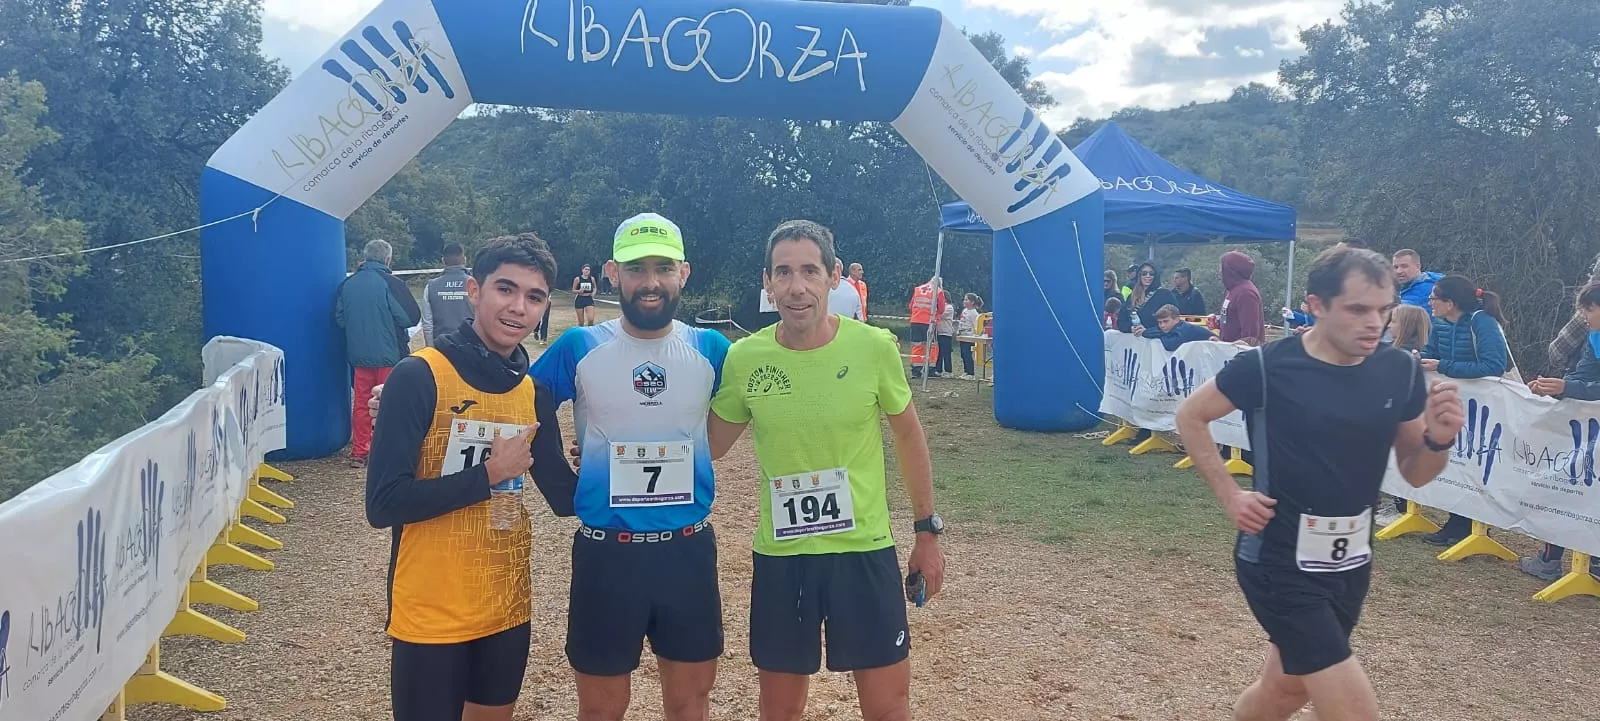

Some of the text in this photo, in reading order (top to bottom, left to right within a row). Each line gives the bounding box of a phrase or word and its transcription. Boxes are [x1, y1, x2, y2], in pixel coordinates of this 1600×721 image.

[521, 0, 868, 92] RIBAGORZA
[349, 113, 409, 170] servicio de deportes
[303, 156, 341, 192] comarca
[341, 145, 353, 160] de
[351, 136, 363, 151] la
[1097, 175, 1229, 199] BAGORZA
[746, 365, 792, 393] BOSTON FINISHER
[643, 466, 662, 494] 7
[783, 492, 841, 525] 194
[1518, 499, 1600, 525] www.deportesribagorza.co
[1331, 537, 1349, 562] 8
